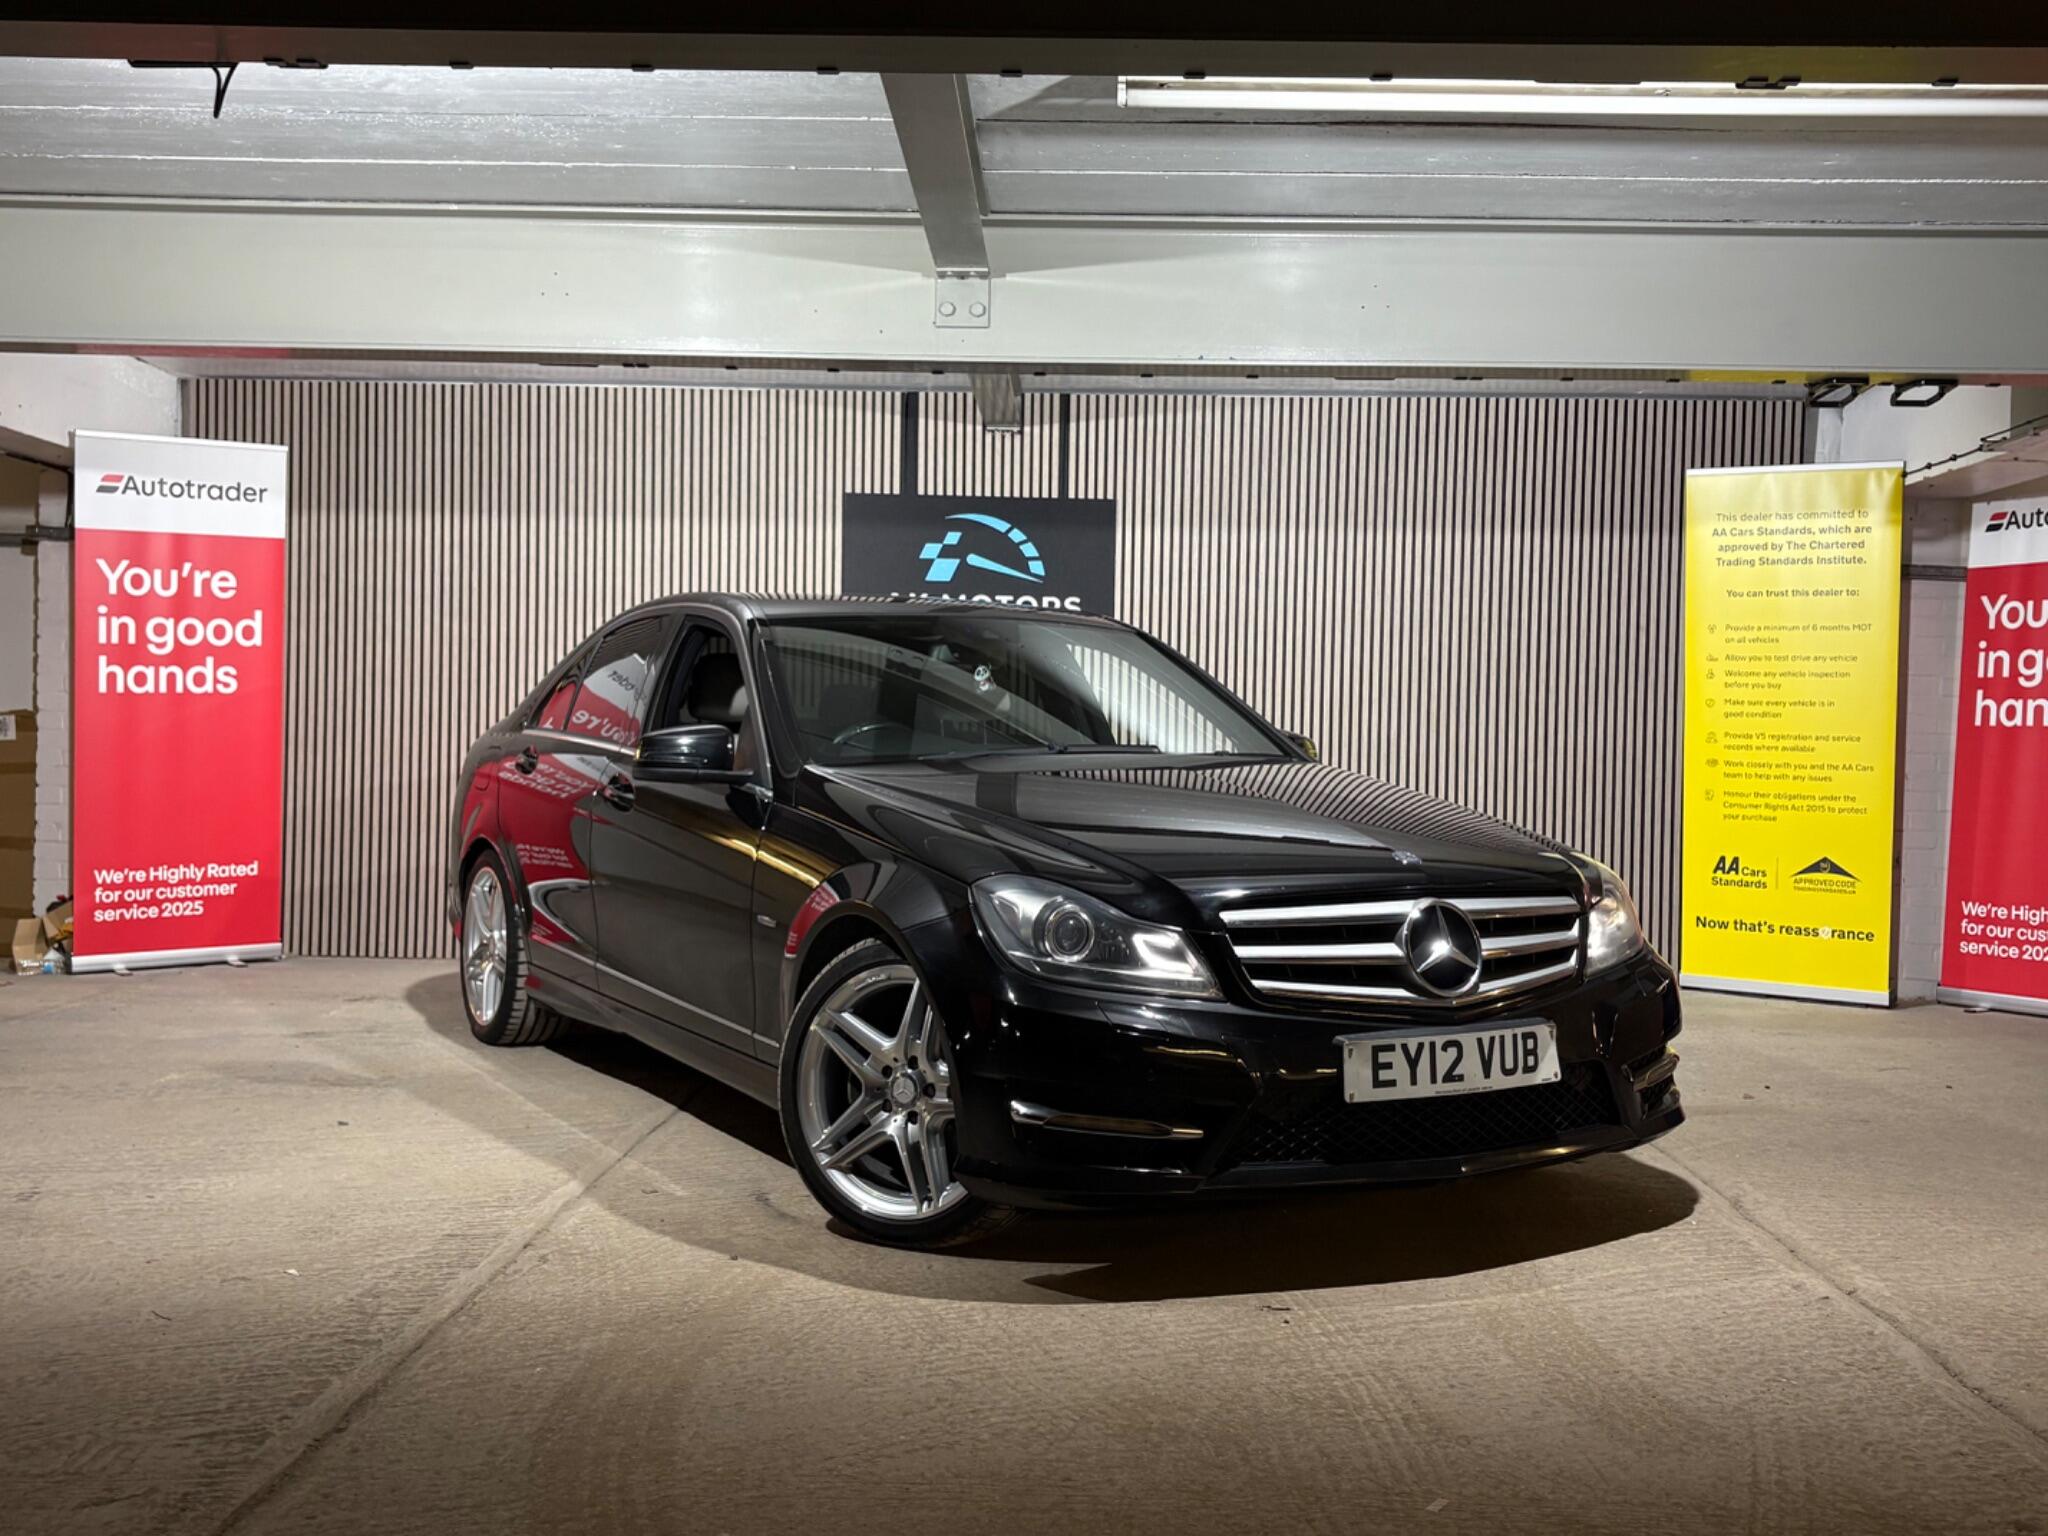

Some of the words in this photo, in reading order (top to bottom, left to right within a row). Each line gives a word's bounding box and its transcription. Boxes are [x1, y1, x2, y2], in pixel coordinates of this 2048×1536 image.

[121, 475, 268, 503] Autotrader
[1716, 512, 1737, 521] This
[1740, 511, 1772, 521] dealer
[1775, 511, 1793, 520] has
[1796, 510, 1855, 519] committed
[1858, 510, 1869, 518] to
[2005, 508, 2048, 530] Aut
[1712, 527, 1727, 536] AA
[1730, 527, 1754, 536] Cars
[1756, 525, 1815, 536] Standards,
[1818, 524, 1851, 535] which
[1854, 525, 1872, 534] are
[1718, 542, 1768, 552] approved
[1771, 542, 1783, 552] by
[1786, 540, 1807, 550] The
[1809, 539, 1865, 550] Chartered
[1716, 556, 1756, 568] Trading
[1759, 555, 1814, 566] Standards
[1816, 555, 1867, 565] Institute.
[96, 558, 237, 599] You're
[1726, 589, 1744, 598] You
[1746, 590, 1763, 598] can
[1766, 589, 1789, 597] trust
[1792, 588, 1810, 597] this
[1812, 588, 1843, 597] dealer
[1846, 588, 1860, 597] to:
[97, 605, 137, 645] in
[145, 609, 263, 655] good
[1725, 623, 1755, 631] Provide
[1801, 623, 1810, 631] of
[1819, 623, 1851, 631] months
[1852, 623, 1872, 631] MOT
[1737, 636, 1746, 644] all
[1748, 636, 1780, 644] vehicles
[1725, 654, 1747, 662] Allow
[1748, 655, 1762, 663] you
[1774, 654, 1789, 662] test
[1791, 654, 1811, 662] drive
[1813, 655, 1827, 663] any
[1829, 654, 1858, 662] vehicle
[1977, 640, 2010, 678] in
[2018, 648, 2048, 688] g
[98, 654, 238, 694] hands
[1725, 670, 1762, 678] Welcome
[1763, 671, 1777, 679] any
[1779, 670, 1806, 678] vehicle
[1808, 670, 1851, 679] inspection
[1725, 681, 1749, 689] before
[1751, 682, 1766, 690] you
[1767, 682, 1782, 690] buy
[1724, 698, 1745, 706] Make
[1765, 700, 1786, 708] every
[1789, 699, 1817, 707] vehicle
[1974, 689, 2048, 728] han
[1723, 711, 1744, 719] good
[1745, 711, 1782, 719] condition
[1768, 733, 1813, 742] registration
[1815, 734, 1829, 742] and
[1832, 735, 1861, 743] service
[1755, 744, 1779, 752] where
[1781, 744, 1815, 753] available
[1746, 761, 1773, 770] closely
[1793, 763, 1808, 771] you
[1810, 763, 1825, 771] and
[1827, 763, 1840, 771] the
[1842, 763, 1853, 771] AA
[1855, 764, 1874, 772] Cars
[1754, 772, 1771, 781] help
[1792, 775, 1806, 783] any
[1808, 774, 1832, 782] issues
[1724, 790, 1752, 798] Honour
[1753, 791, 1772, 799] their
[1773, 792, 1816, 801] obligations
[1818, 794, 1840, 802] under
[1843, 794, 1856, 803] the
[1723, 801, 1762, 809] Consumer
[1764, 802, 1789, 811] Rights
[1791, 803, 1804, 811] Act
[1806, 804, 1825, 812] 2015
[1838, 806, 1868, 815] protect
[1741, 813, 1777, 822] purchase
[94, 868, 146, 885] We're
[150, 863, 205, 885] Highly
[207, 860, 258, 878] Rated
[1713, 855, 1739, 875] AA
[1741, 866, 1767, 878] Cars
[1711, 876, 1768, 889] Standards
[1793, 877, 1835, 887] APPROVED
[1836, 879, 1856, 889] CODE
[94, 887, 122, 903] for
[124, 889, 153, 902] our
[156, 882, 238, 899] customer
[94, 904, 159, 922] service
[161, 901, 204, 917] 2025
[1961, 901, 2008, 919] We're
[1696, 916, 1729, 929] Now
[1733, 918, 1775, 934] that's
[1779, 925, 1875, 942] reassrance
[1961, 919, 1984, 935] for
[1986, 925, 2015, 939] our
[2017, 927, 2048, 942] cus
[1960, 940, 2019, 958] service
[1371, 1039, 1465, 1089] EY12
[1476, 1031, 1539, 1080] VUB
